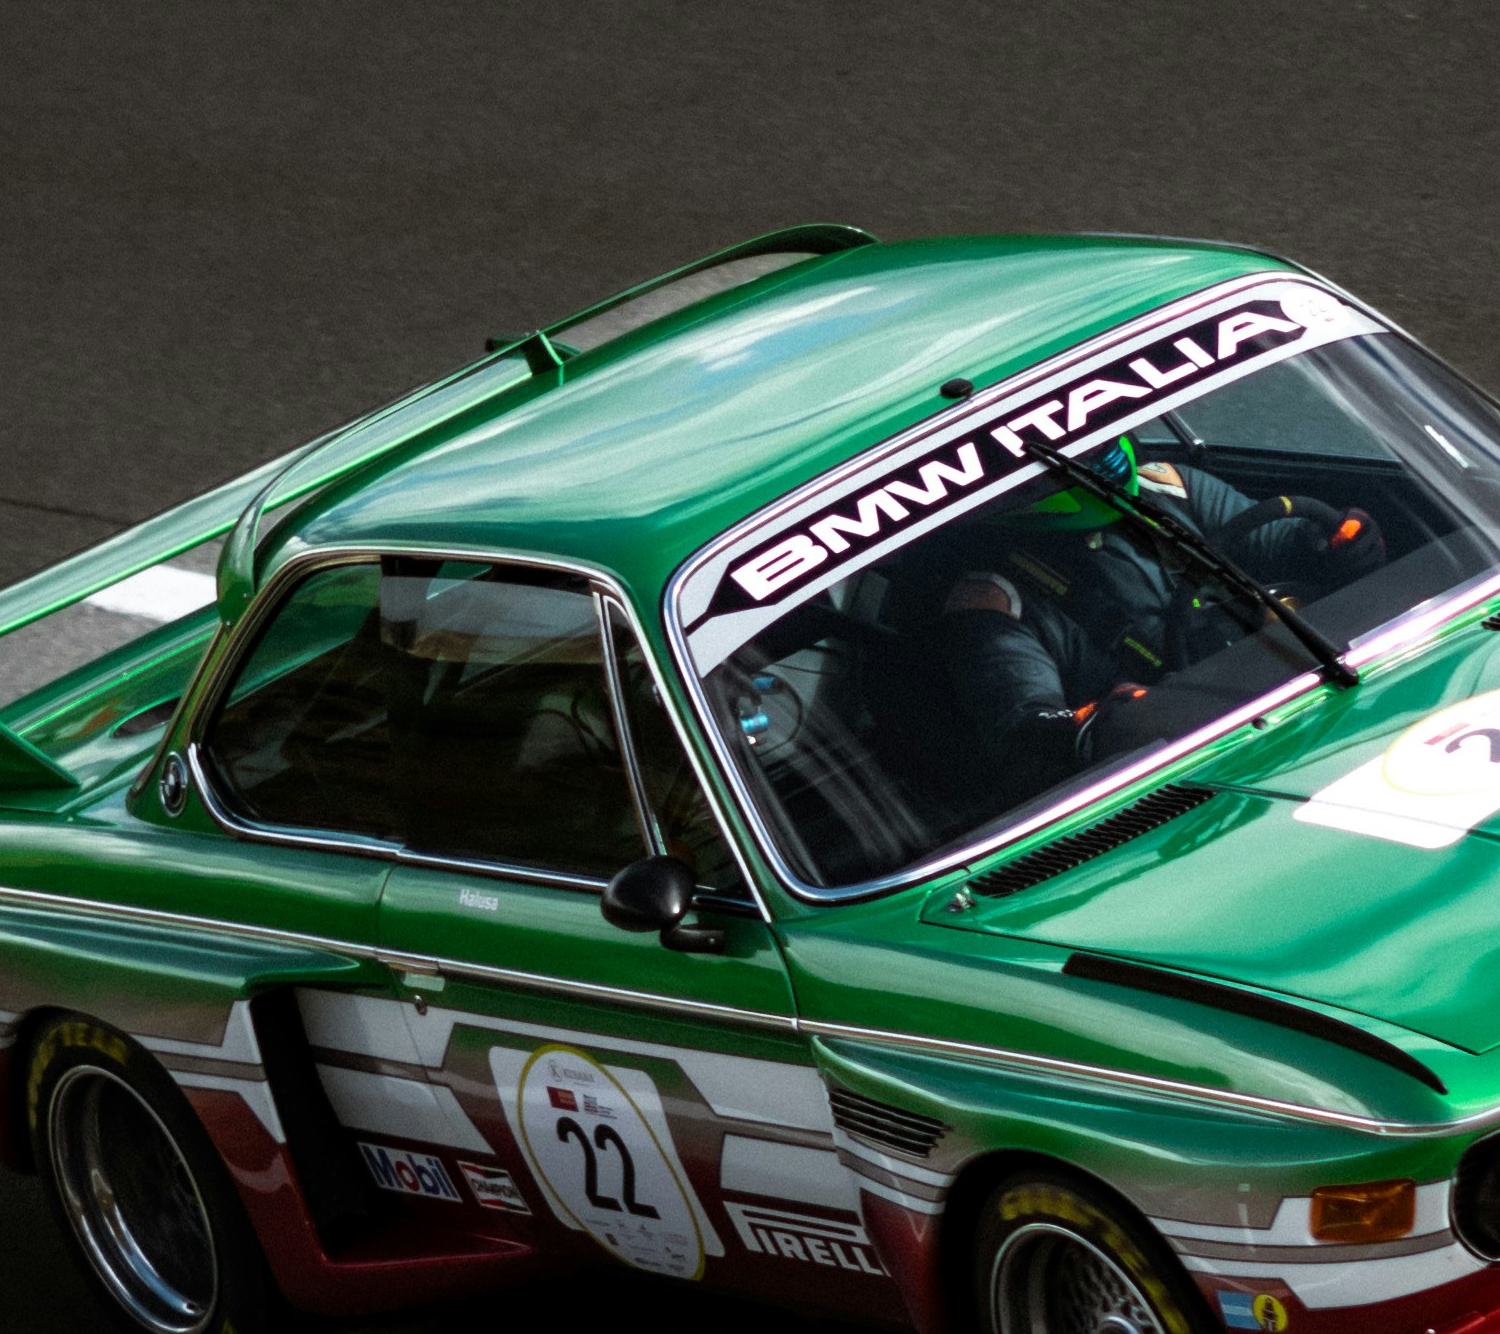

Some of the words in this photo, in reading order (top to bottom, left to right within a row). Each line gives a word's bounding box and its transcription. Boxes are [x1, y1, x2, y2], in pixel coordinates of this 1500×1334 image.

[731, 441, 985, 601] BMW
[990, 309, 1303, 458] ITALIA
[361, 1144, 460, 1200] Mobil
[556, 1117, 660, 1220] 22
